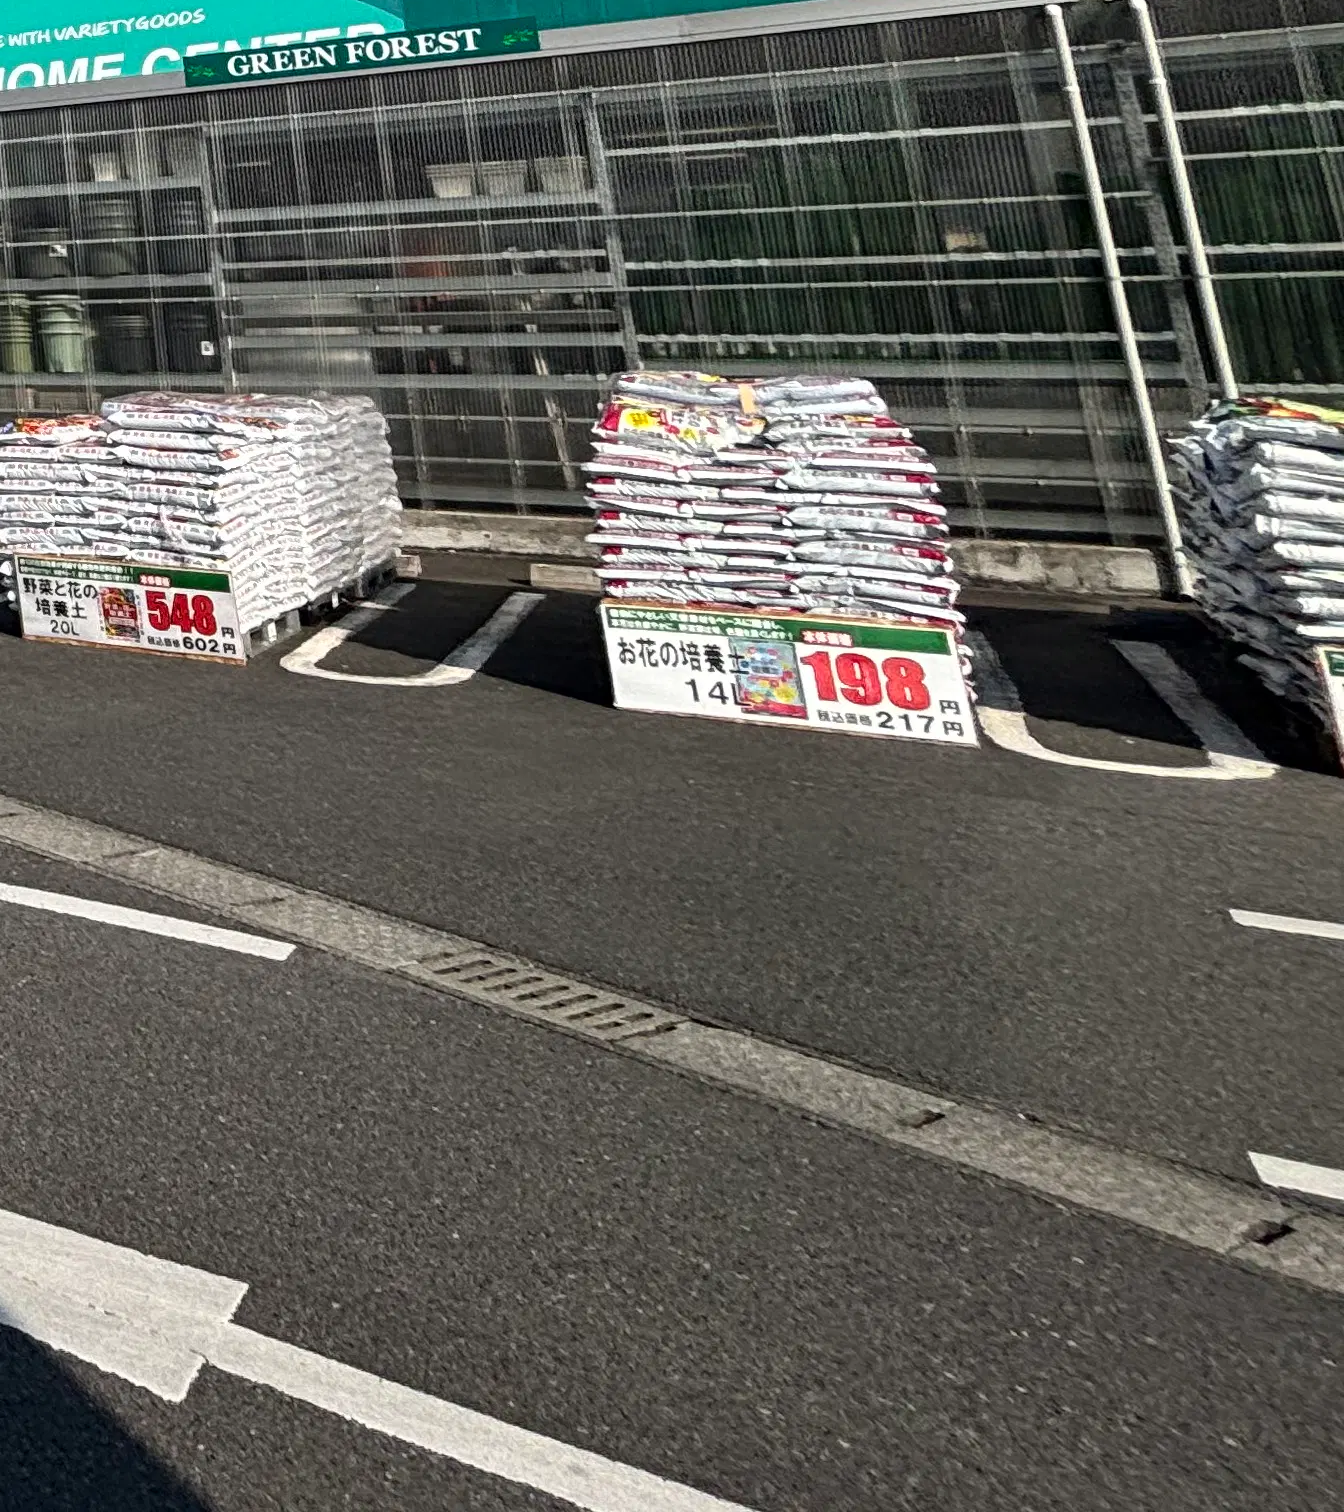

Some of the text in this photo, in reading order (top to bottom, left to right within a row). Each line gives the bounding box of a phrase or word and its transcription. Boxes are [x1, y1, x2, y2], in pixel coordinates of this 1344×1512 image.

[8, 29, 51, 47] WITH
[227, 44, 338, 77] GREEN
[345, 28, 482, 65] FOREST
[23, 577, 98, 600] 野菜と花の
[35, 597, 88, 620] 培養土
[145, 590, 218, 637] 548
[50, 619, 80, 636] 20L
[617, 636, 750, 675] お花の培養土
[685, 677, 754, 708] 14L
[800, 651, 931, 711] 198
